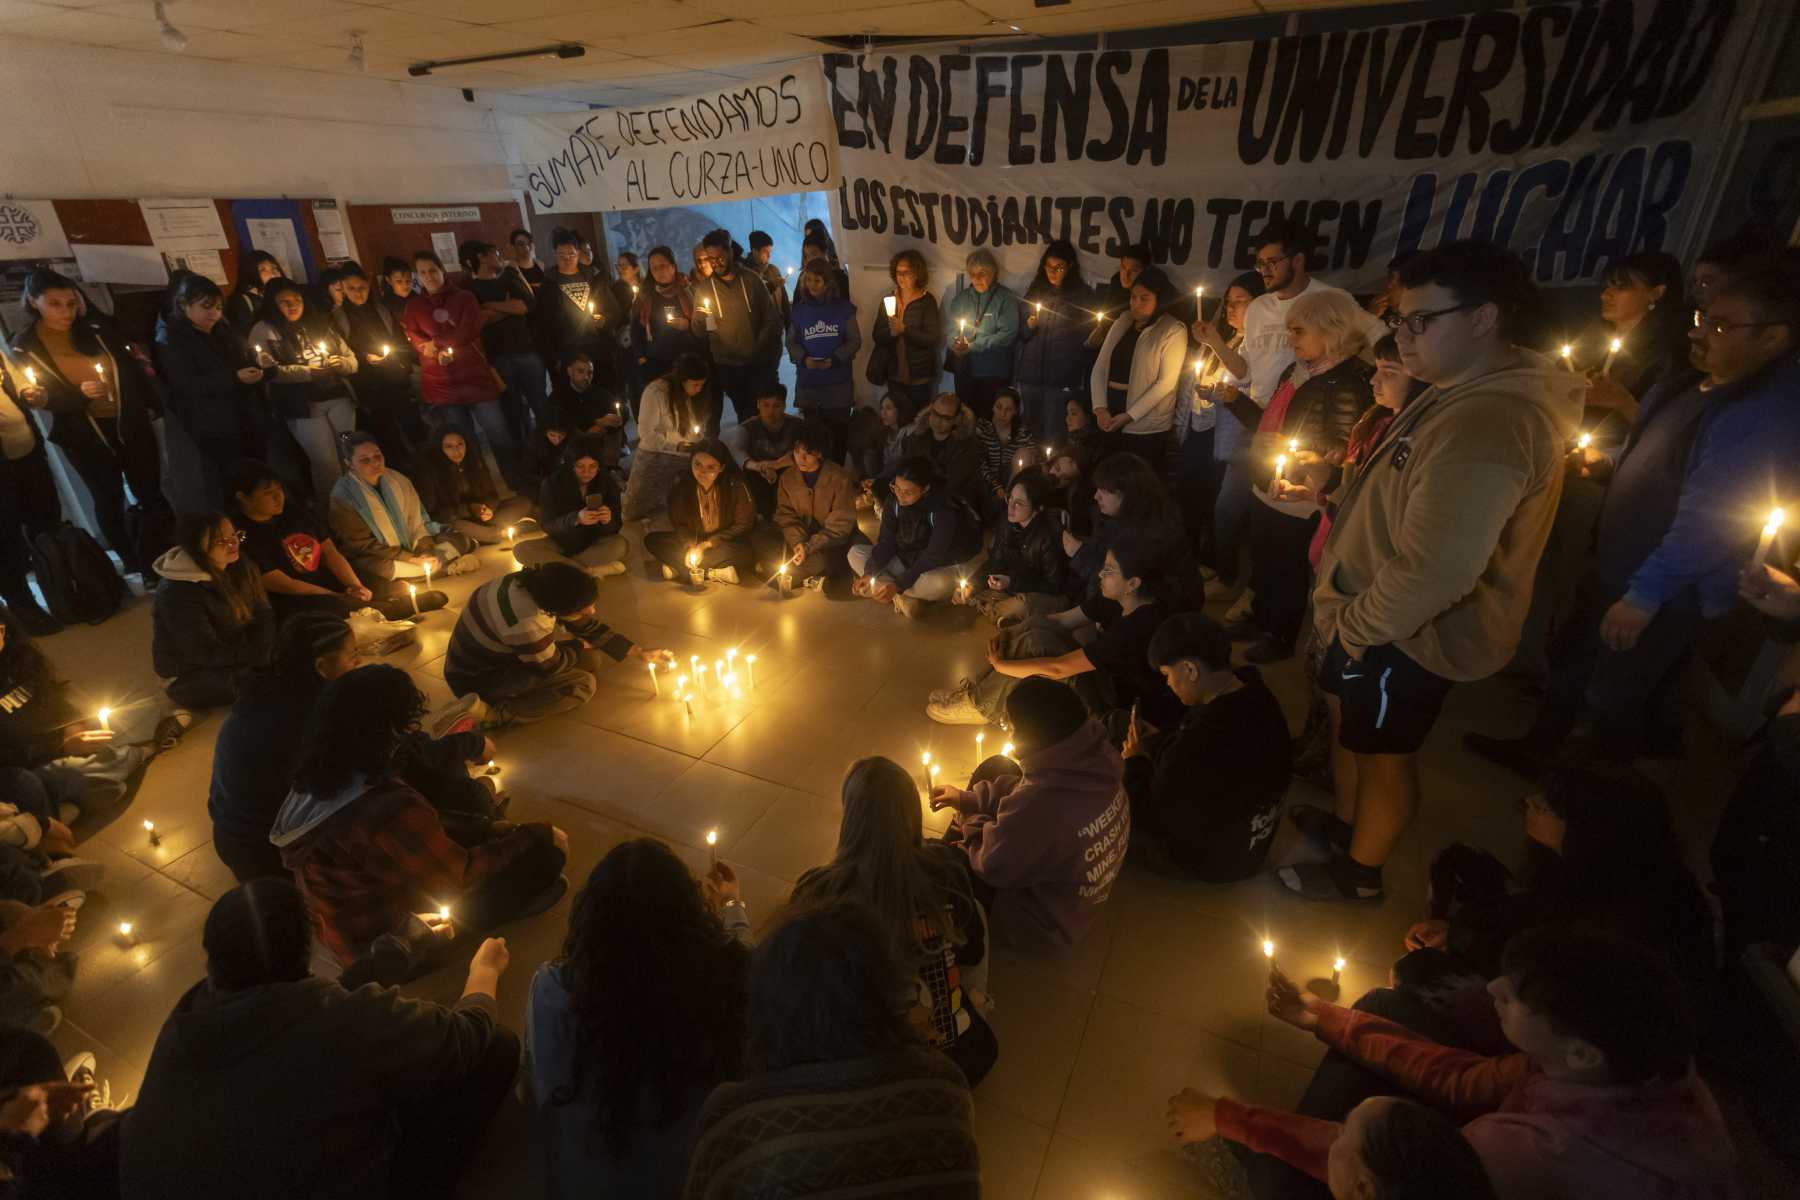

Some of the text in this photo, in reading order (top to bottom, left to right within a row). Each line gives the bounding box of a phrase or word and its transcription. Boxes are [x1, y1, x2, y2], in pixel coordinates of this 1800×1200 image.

[823, 0, 1734, 166] EN DEFENSA DE LA UNIVERSIDAD
[529, 75, 802, 208] SUMATE DEFENDAMOS
[626, 141, 830, 203] AL CURZA-UNCO
[839, 176, 887, 234] LOS
[1141, 198, 1195, 266] NO
